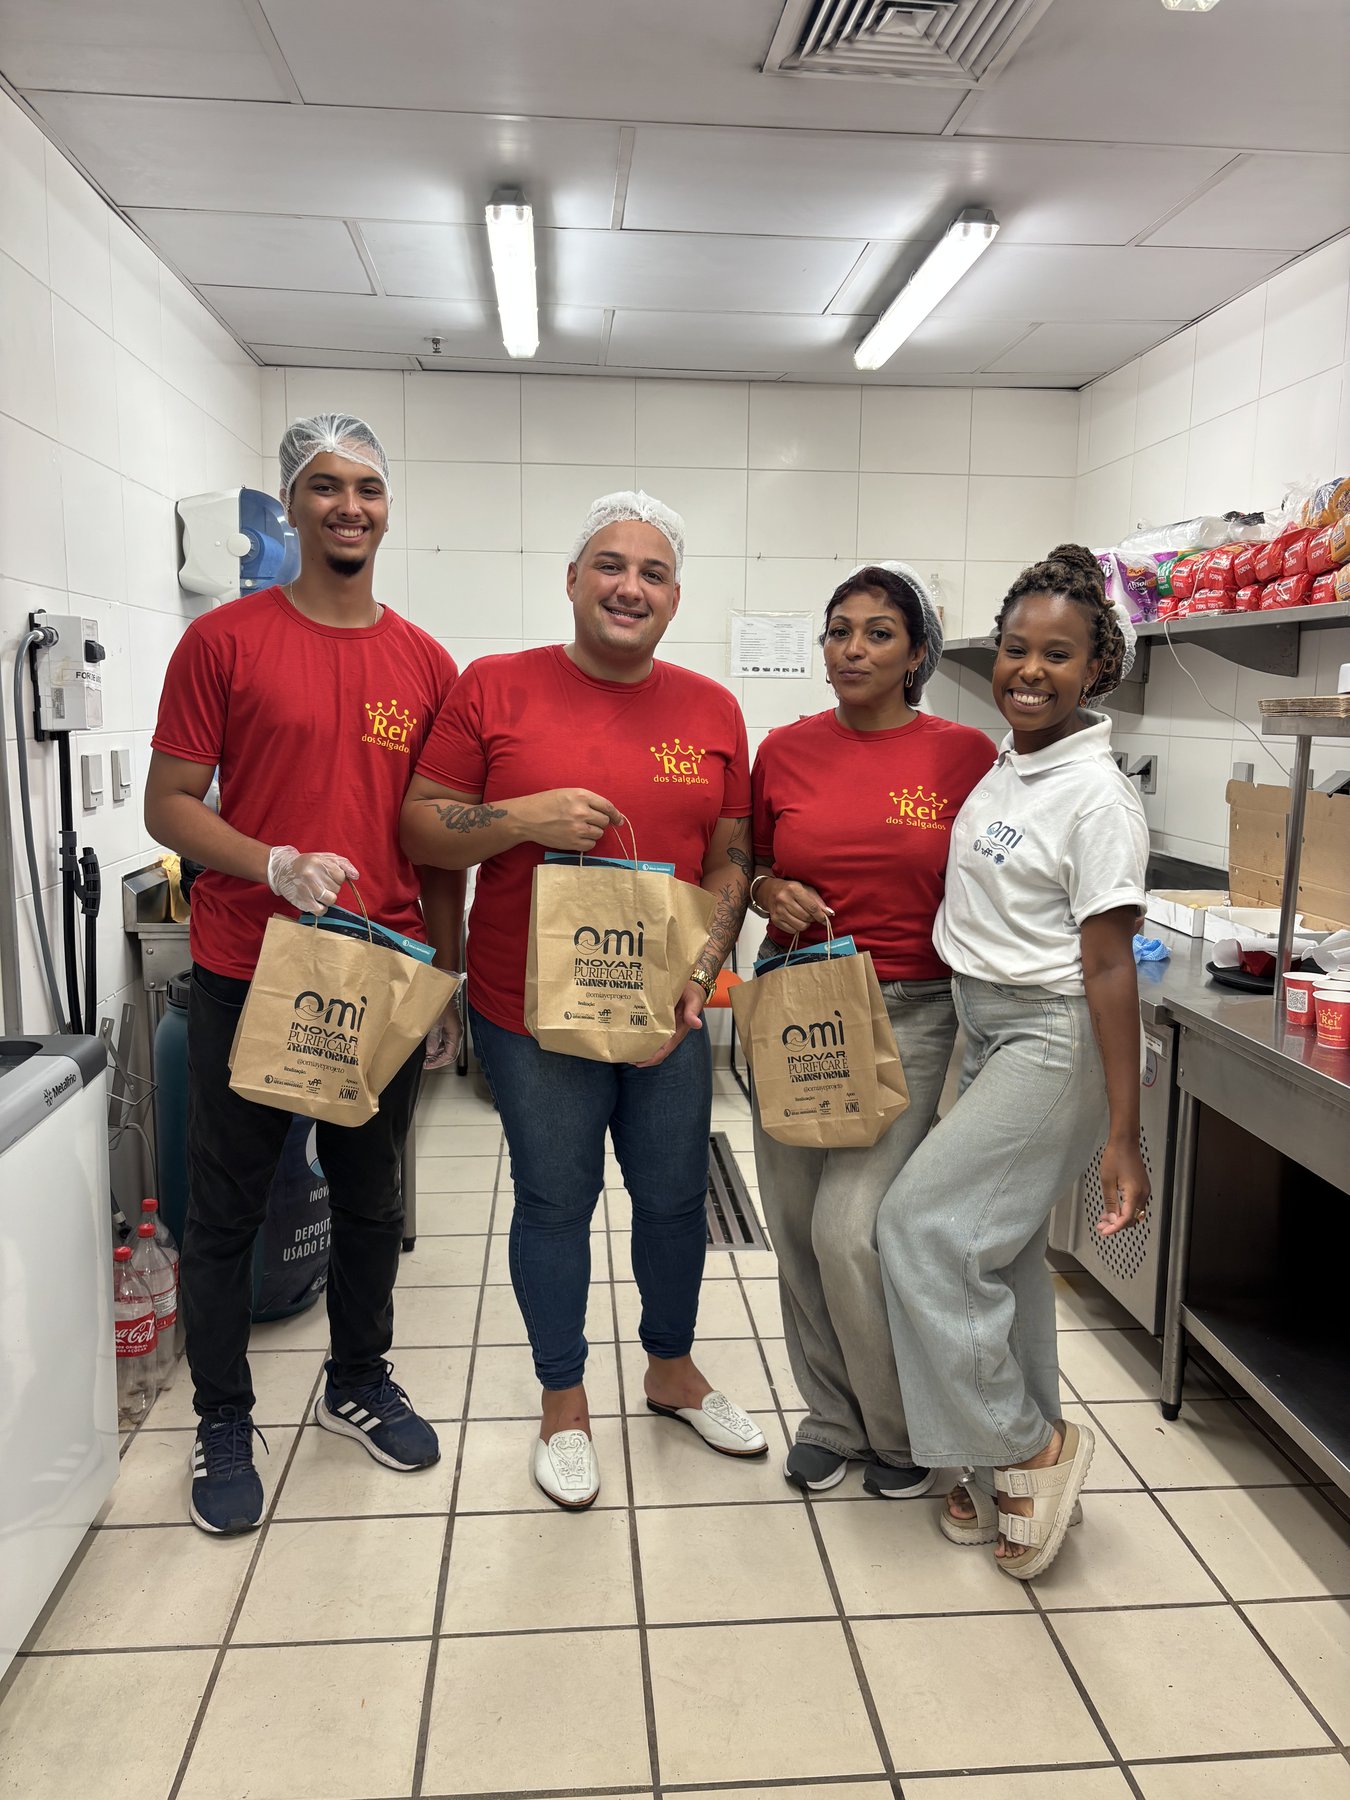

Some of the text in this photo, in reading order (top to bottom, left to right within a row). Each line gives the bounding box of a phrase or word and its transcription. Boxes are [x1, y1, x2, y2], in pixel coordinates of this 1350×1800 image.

[373, 715, 407, 743] Rei
[361, 733, 410, 754] dos Salgado
[663, 755, 698, 775] Rei
[653, 774, 709, 786] dos Salgados
[900, 799, 937, 820] Rei
[885, 816, 946, 831] dos Salgados
[574, 965, 643, 981] PURIFICAR E
[574, 977, 644, 990] TRANSFORMAR
[630, 1014, 648, 1026] KING
[1321, 1015, 1337, 1026] Rei
[288, 1030, 351, 1056] PURIFICAR
[286, 1041, 359, 1066] TRANSFORMAR
[788, 1058, 849, 1075] PURIFICAR E
[52, 1073, 77, 1098] Metalfrio
[338, 1087, 358, 1101] KING
[844, 1101, 860, 1113] KING
[295, 1217, 331, 1242] DEPOSIT
[283, 1240, 317, 1262] USADO
[319, 1236, 325, 1252] E
